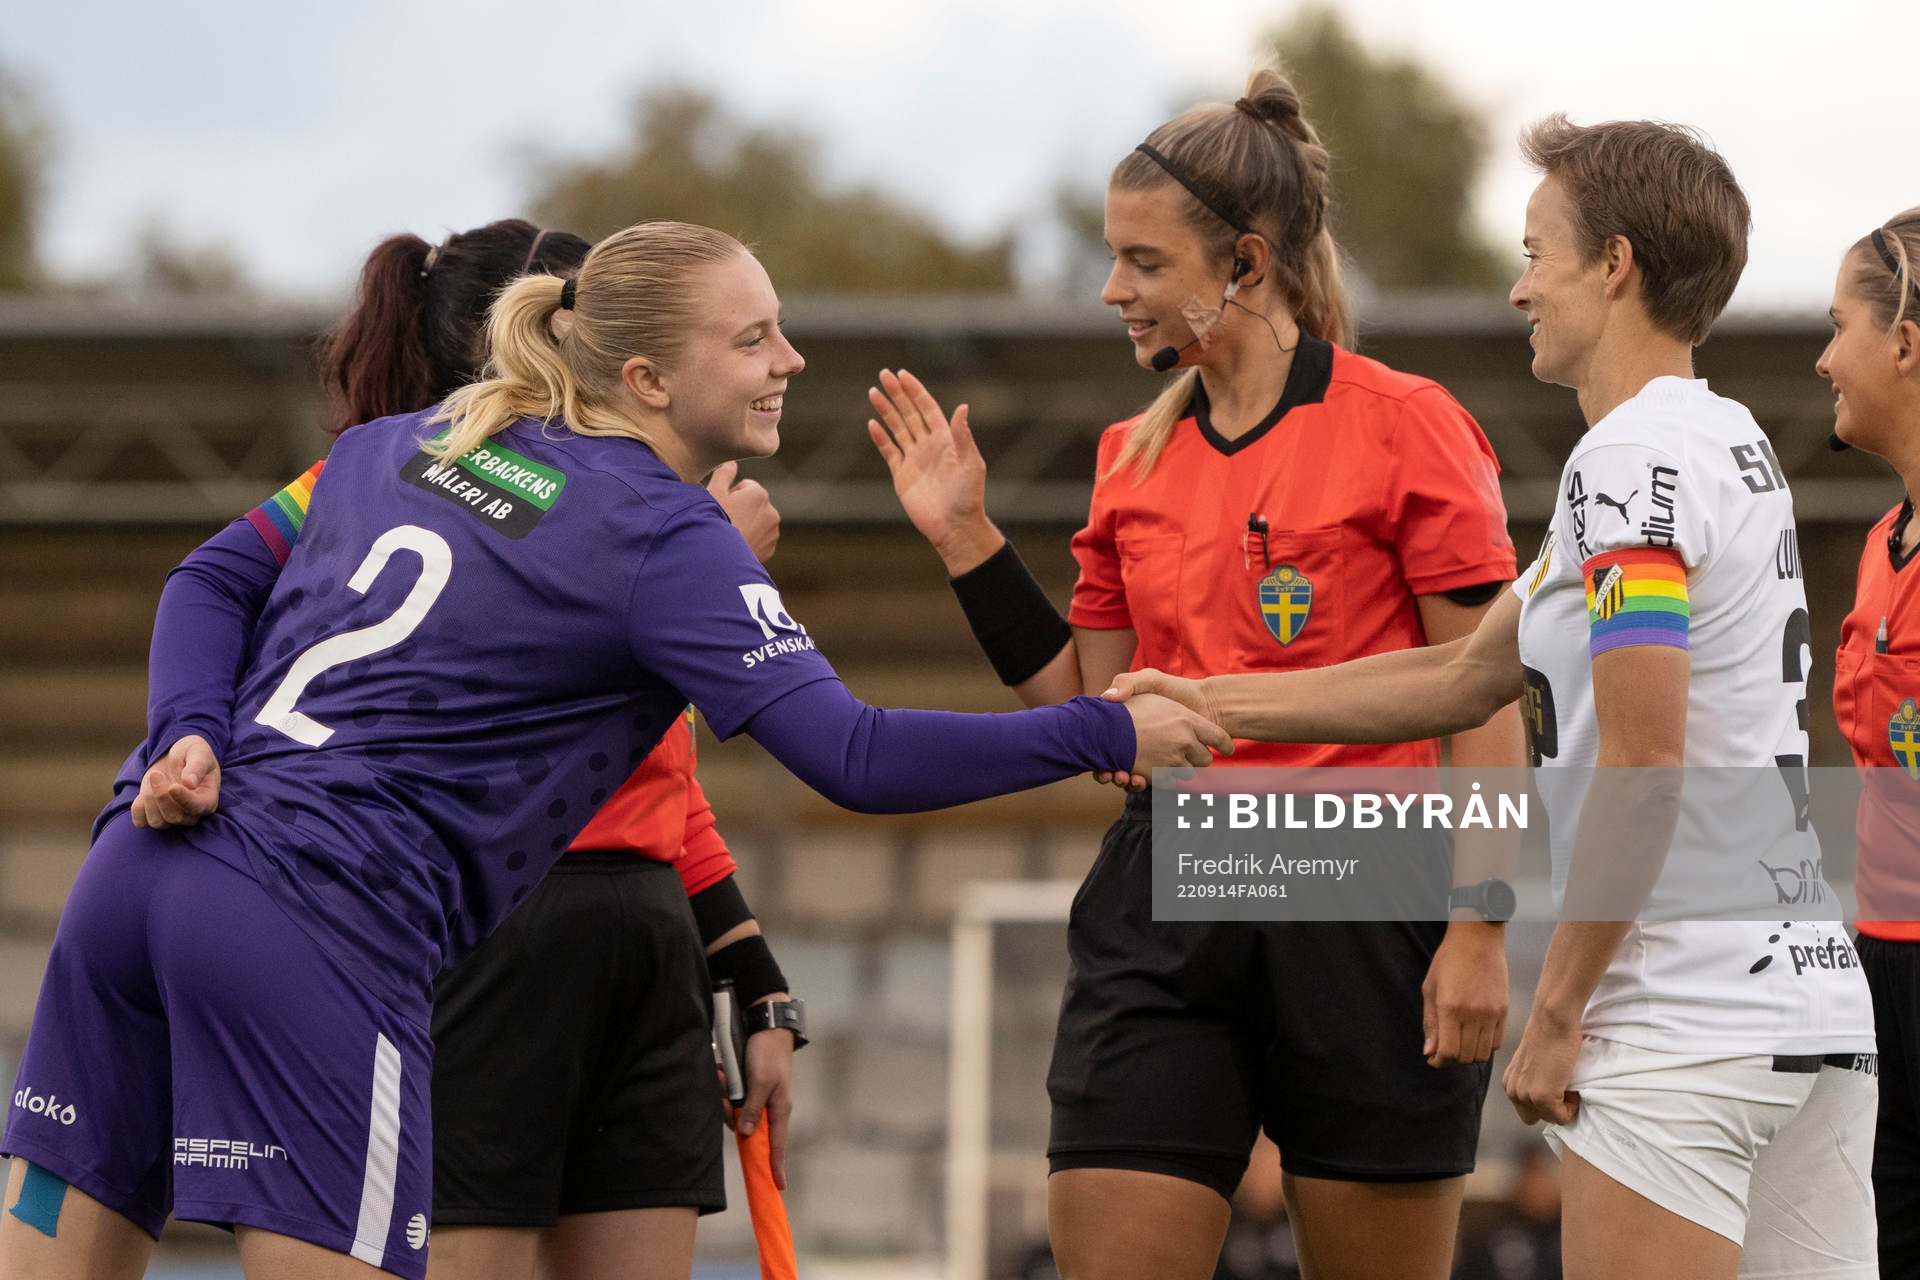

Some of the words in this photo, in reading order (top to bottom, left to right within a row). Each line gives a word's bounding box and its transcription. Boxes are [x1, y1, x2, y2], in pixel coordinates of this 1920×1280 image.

[421, 463, 488, 506] MÅLERI
[481, 498, 513, 520] AB
[254, 524, 453, 747] 2
[742, 635, 815, 669] SVENSKA
[173, 1152, 248, 1170] RAMM
